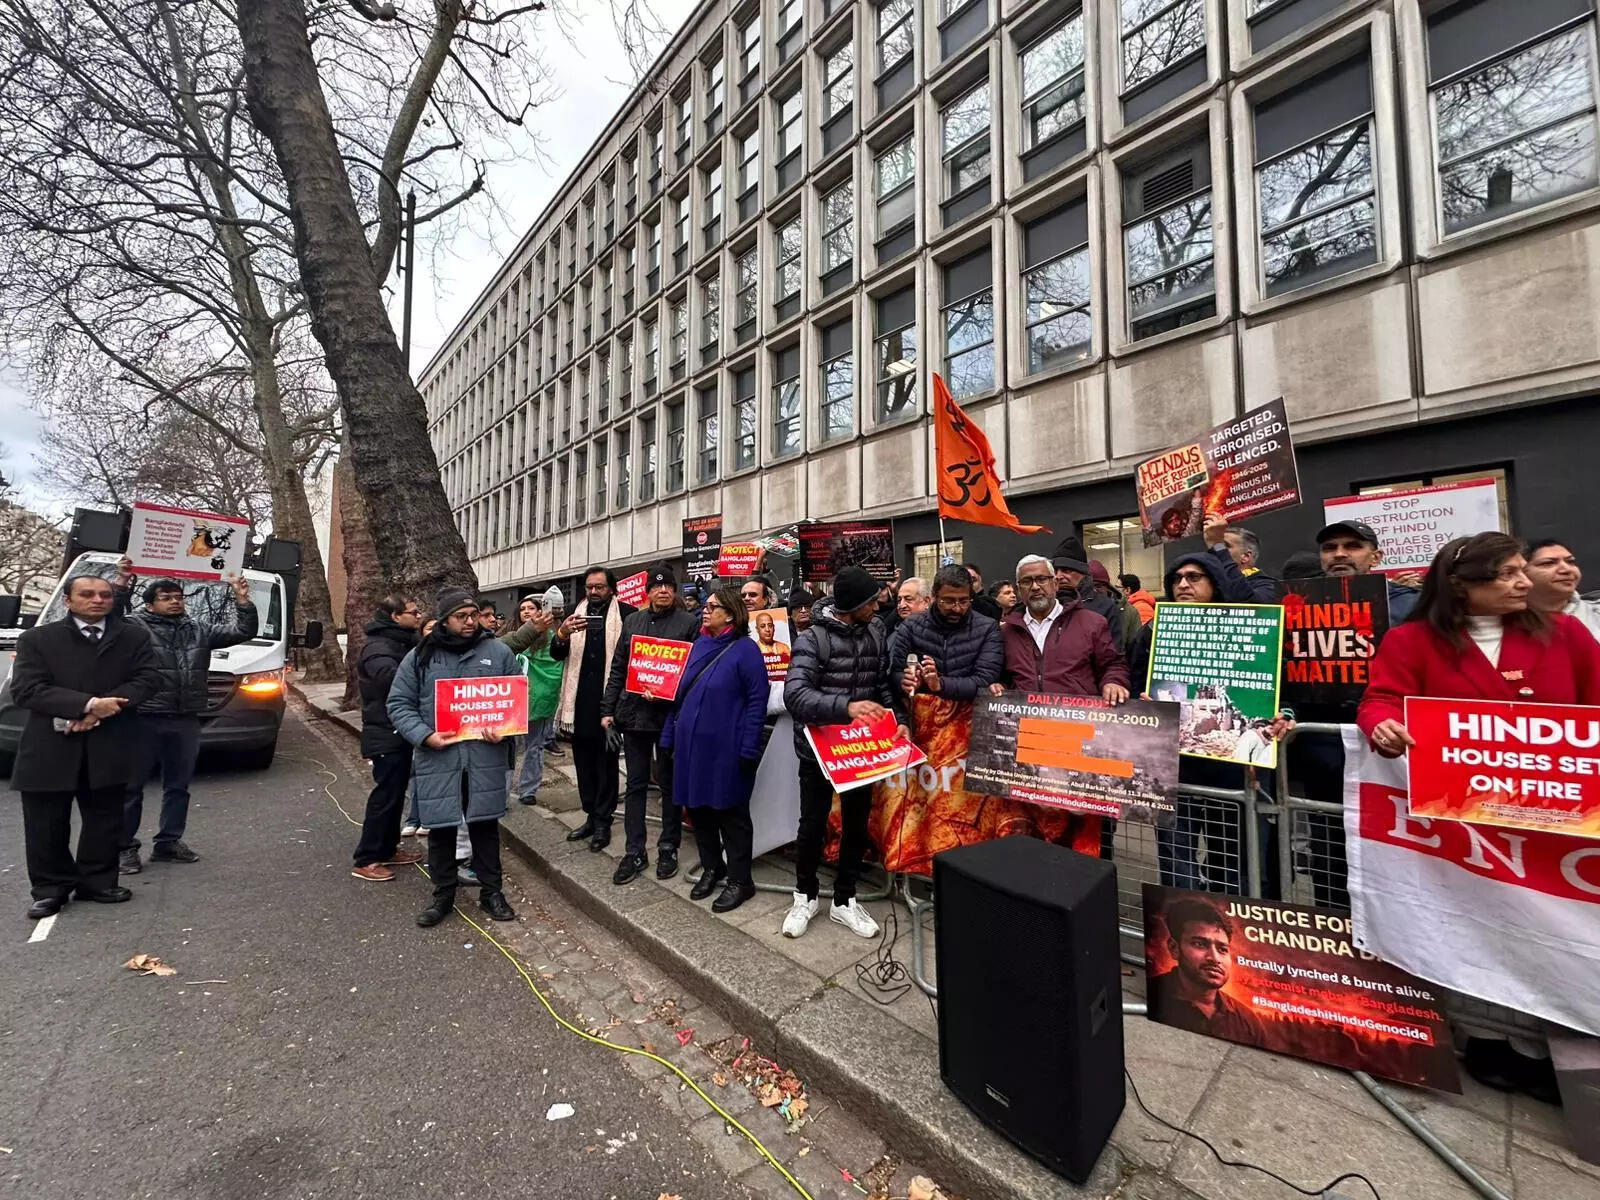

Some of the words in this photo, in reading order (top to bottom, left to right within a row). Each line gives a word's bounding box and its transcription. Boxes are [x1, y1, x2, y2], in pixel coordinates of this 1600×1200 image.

[1210, 410, 1276, 444] TARGETED.
[1206, 422, 1286, 460] TERRORISED.
[1140, 446, 1200, 484] HINDUS
[1217, 440, 1281, 471] SILENCED.
[1142, 476, 1170, 496] HAVE
[1171, 462, 1202, 482] RIGHT
[1231, 462, 1268, 480] 1946-2025
[1230, 476, 1260, 493] HINDUS
[1262, 473, 1271, 482] IN
[1146, 494, 1158, 504] TO
[1160, 482, 1184, 498] LIVE
[1226, 482, 1280, 506] BANGLADESH
[1224, 492, 1295, 518] ladeshiHinduGenocide
[1382, 498, 1420, 510] STOP
[1354, 507, 1453, 525] DESTRUCTION
[1394, 522, 1436, 534] HINDU
[1378, 535, 1430, 547] MPLAES
[1434, 532, 1454, 542] BY
[722, 546, 758, 554] PROTECT
[1379, 553, 1434, 565] NGLADE
[1160, 606, 1182, 614] THERE
[1286, 602, 1371, 629] HINDU
[1246, 618, 1278, 626] REGION
[634, 642, 686, 661] PROTECT
[1196, 642, 1226, 650] BARELY
[1292, 629, 1376, 658] LIVES
[1154, 656, 1180, 664] EITHER
[1182, 658, 1212, 666] HAVING
[1213, 660, 1233, 668] BEEN
[1220, 652, 1256, 661] TEMPLES
[630, 658, 681, 675] BANGLADESH
[1154, 664, 1200, 674] DEMOLISHED
[1220, 670, 1273, 680] DESECRATED
[1287, 660, 1369, 684] MATTE
[637, 672, 664, 686] HINDUS
[1164, 674, 1209, 684] CONVERTED
[1210, 678, 1230, 686] INTO
[1231, 680, 1274, 690] MOSQUES.
[454, 683, 512, 699] HINDU
[1026, 694, 1060, 706] DAILY
[450, 702, 494, 712] HOUSES
[496, 700, 515, 708] SET
[988, 702, 1048, 716] MIGRATION
[1050, 708, 1086, 720] RATES
[1088, 711, 1160, 728] (1971-2001)
[461, 715, 479, 724] ON
[482, 712, 505, 721] FIRE
[840, 726, 872, 740] SAVE
[1448, 712, 1600, 748] HINDU
[831, 742, 878, 756] HINDUS
[878, 738, 893, 749] IN
[826, 744, 912, 772] BANGLADESH
[1442, 747, 1552, 772] HOUSES
[1558, 755, 1600, 776] SET
[1470, 775, 1514, 793] ON
[1521, 778, 1582, 800] FIRE
[1012, 788, 1120, 814] #BangladeshiHinduGenocide
[1225, 902, 1311, 929] JUSTICE
[1244, 926, 1353, 958] CHANDRA
[1237, 955, 1286, 976] Brutally
[1286, 964, 1340, 984] lynched
[1341, 974, 1352, 986] &
[1354, 976, 1394, 994] burnt
[1396, 984, 1436, 1001] alive.
[1252, 996, 1428, 1040] #BangladeshiHinduGenocide
